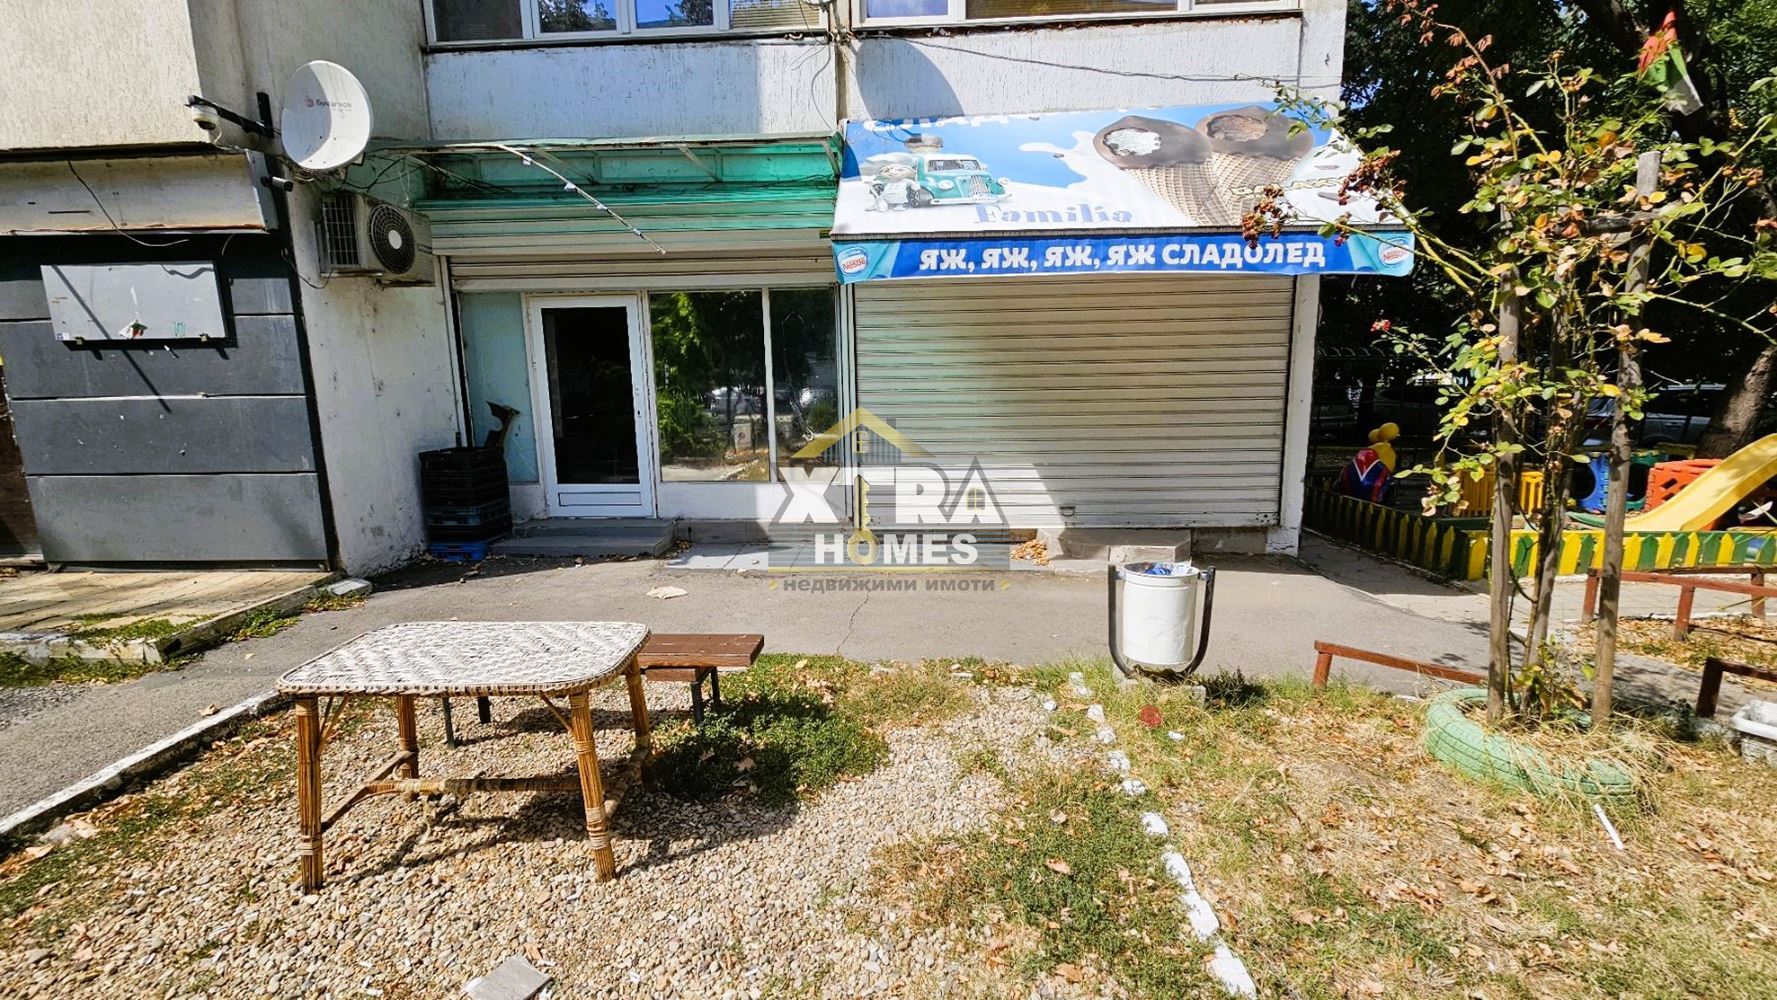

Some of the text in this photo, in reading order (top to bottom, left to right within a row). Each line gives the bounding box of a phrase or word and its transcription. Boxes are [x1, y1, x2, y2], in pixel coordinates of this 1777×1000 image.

[974, 203, 1133, 223] Familia
[919, 242, 1326, 273] ЯЖ, ЯЖ, ЯЖ, ЯЖ СЛАДОЛЕД
